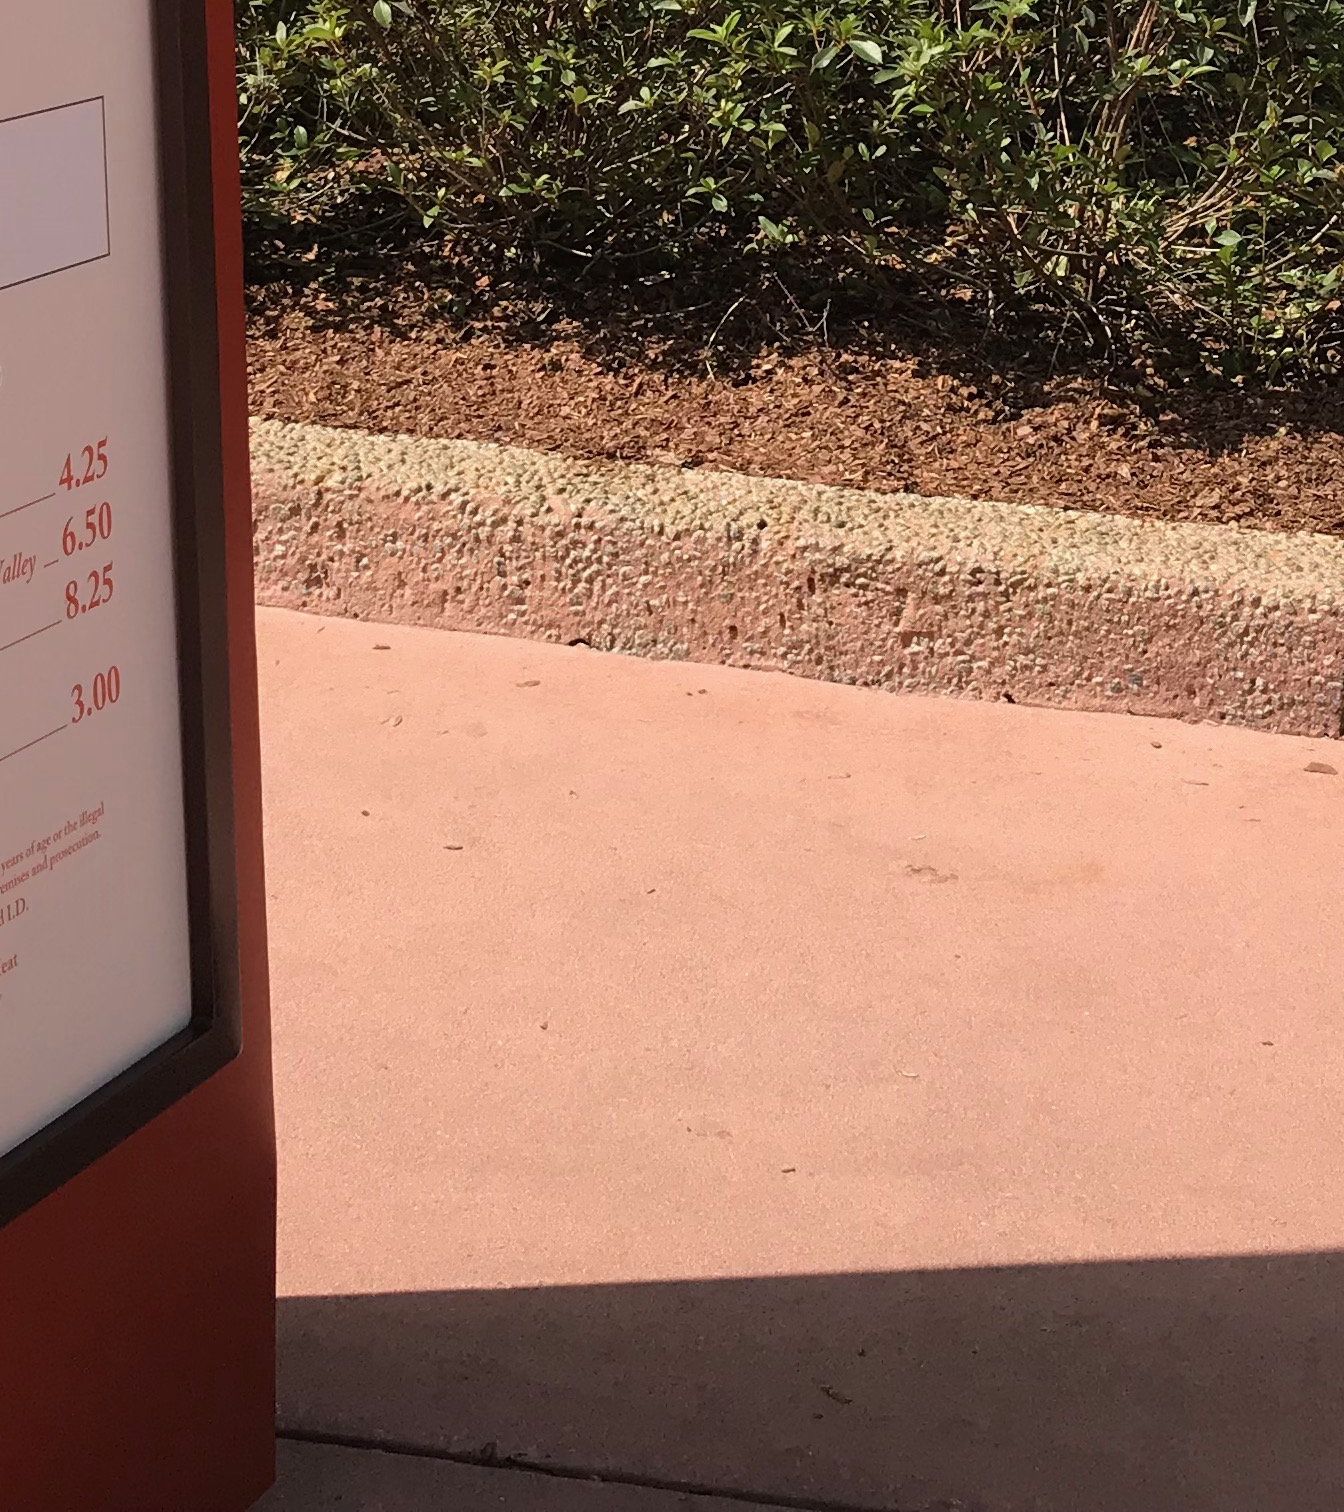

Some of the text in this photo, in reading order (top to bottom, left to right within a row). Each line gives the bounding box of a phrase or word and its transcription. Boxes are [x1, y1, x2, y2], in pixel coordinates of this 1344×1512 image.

[57, 435, 108, 492] 4.25
[61, 500, 113, 557] 6.50
[63, 559, 114, 620] 8.25
[70, 664, 121, 724] 3.00
[5, 896, 29, 922] I.D.
